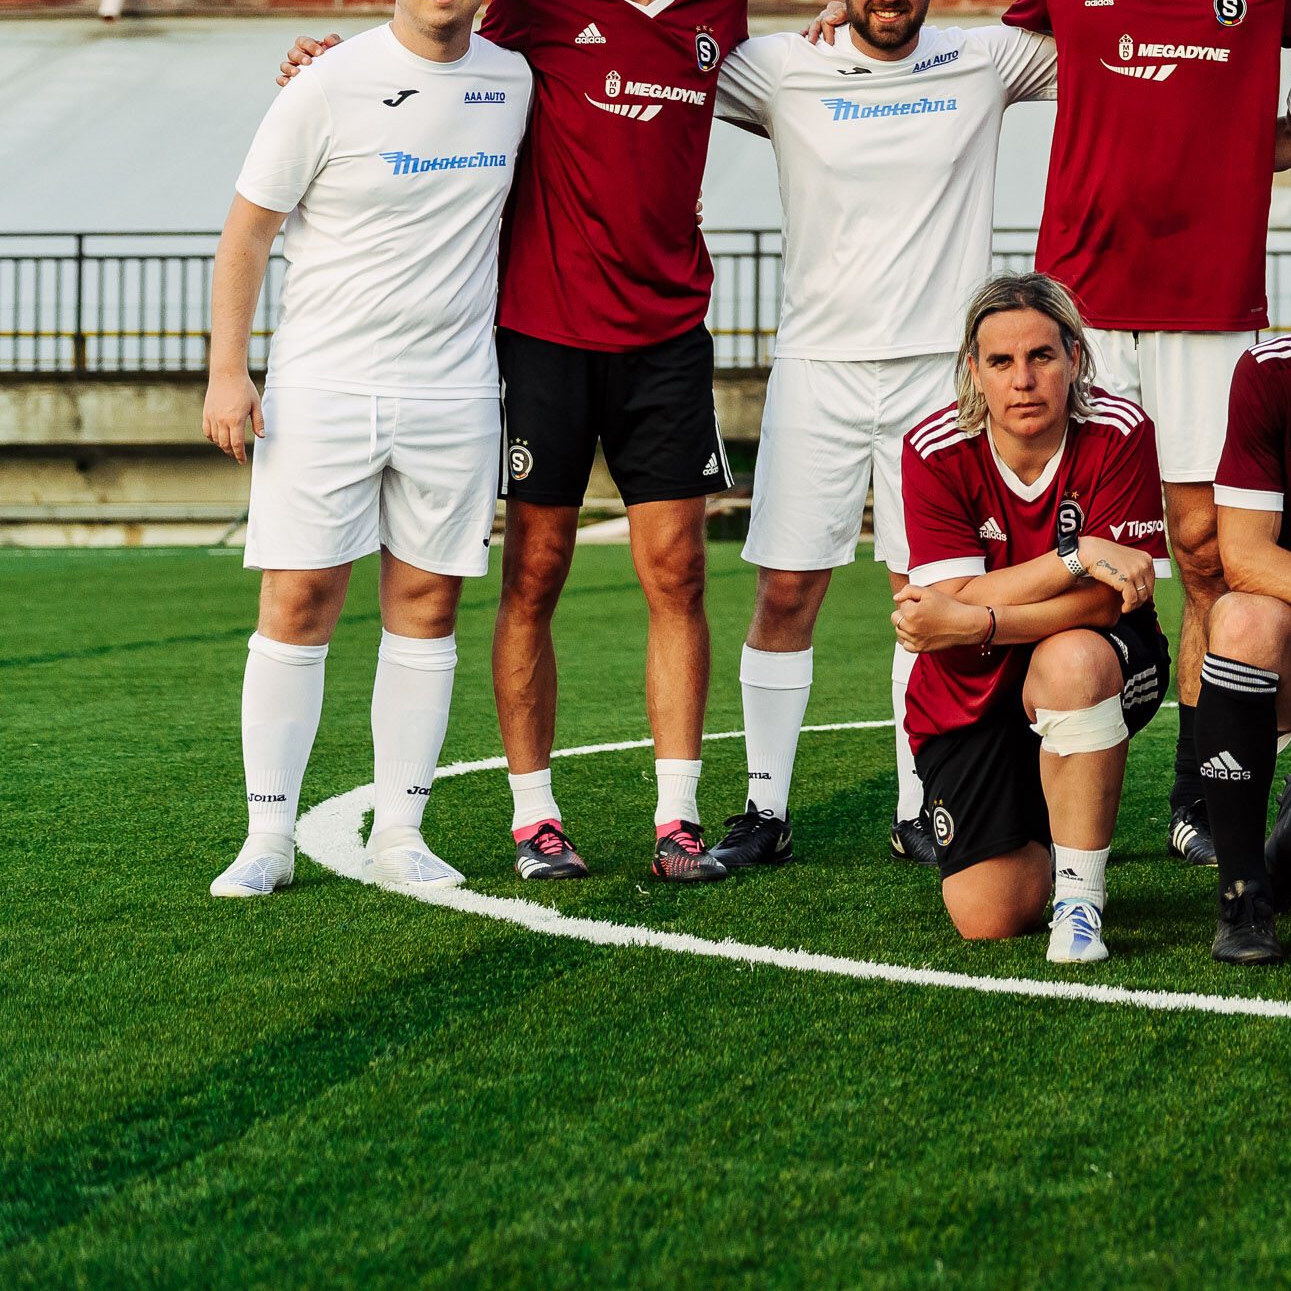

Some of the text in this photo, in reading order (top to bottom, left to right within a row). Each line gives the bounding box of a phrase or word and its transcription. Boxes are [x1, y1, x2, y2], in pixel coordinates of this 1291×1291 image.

[575, 36, 606, 44] adidas
[913, 50, 959, 72] AAA AUTO
[1137, 43, 1231, 62] MEGADYNE
[464, 92, 506, 101] AAA AUTO
[624, 81, 707, 106] MEGADYNE
[820, 98, 958, 121] Mototechna
[379, 151, 507, 175] Mototechna
[1200, 766, 1251, 780] adidas
[248, 793, 287, 803] Joma
